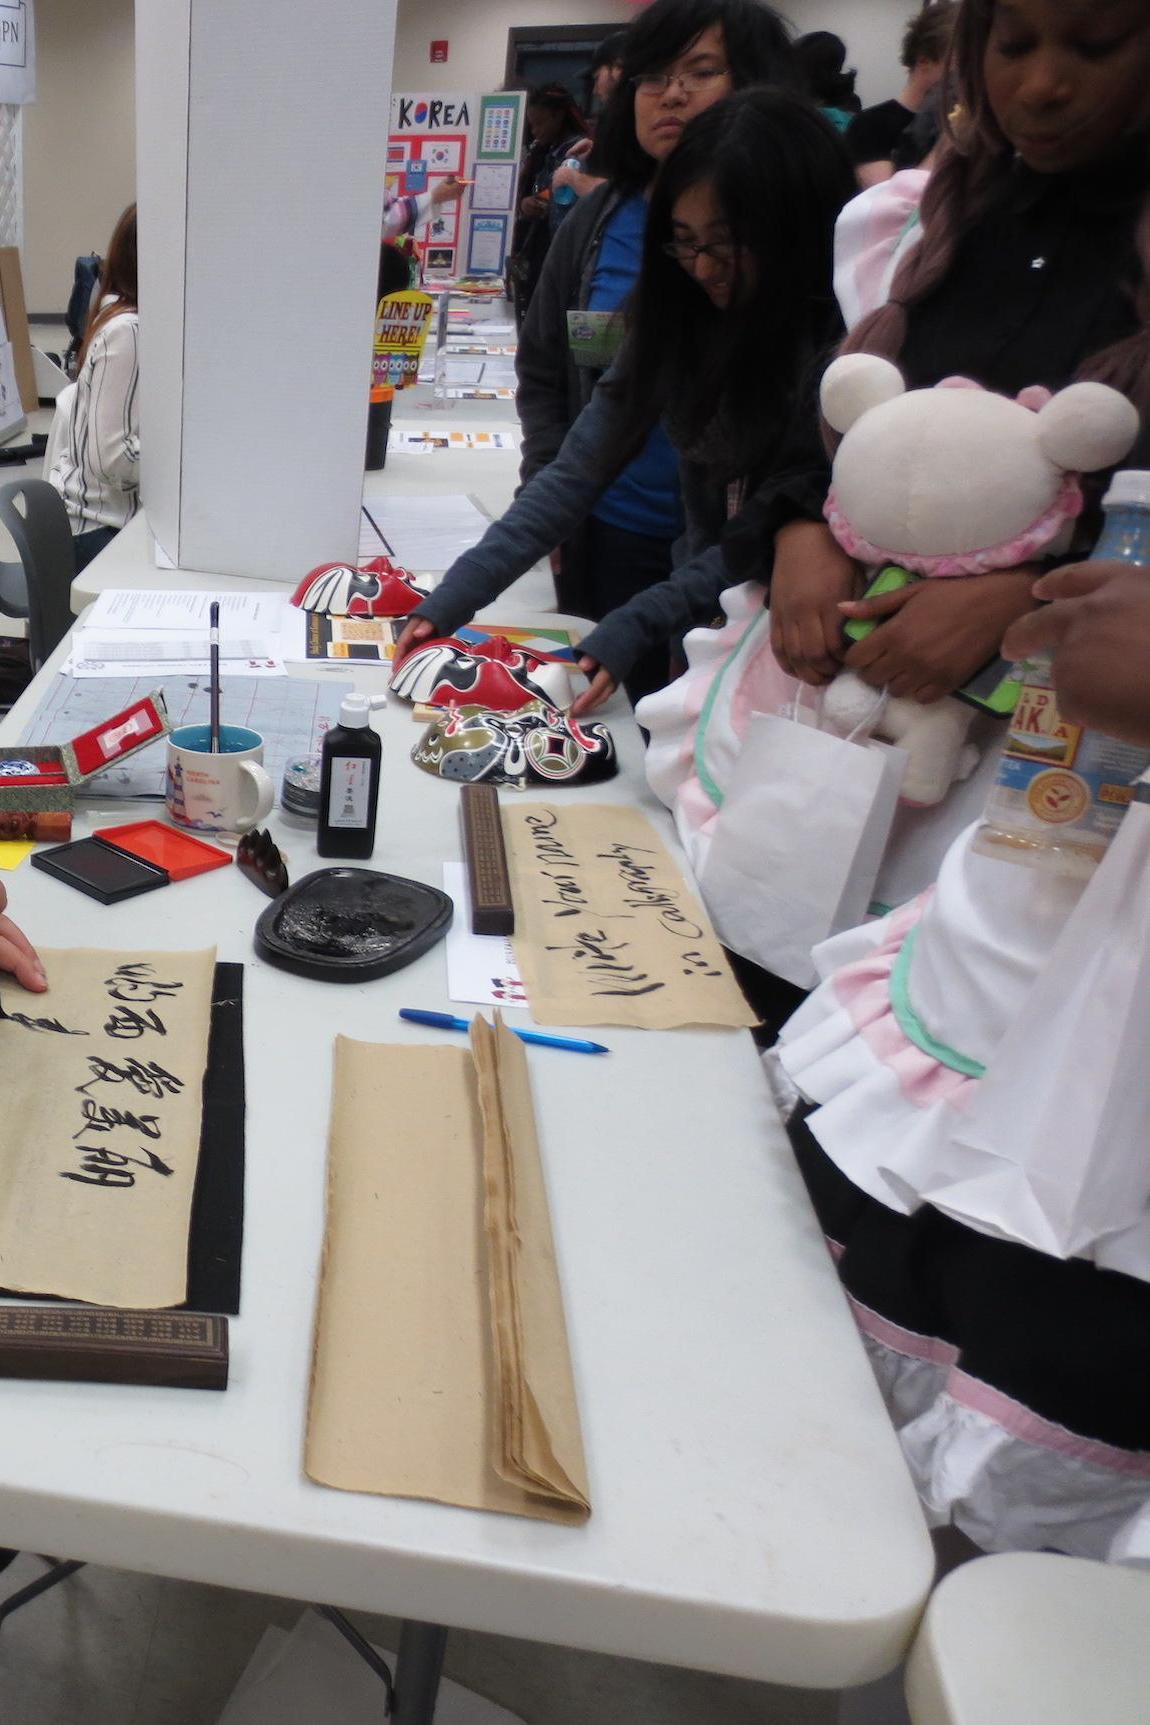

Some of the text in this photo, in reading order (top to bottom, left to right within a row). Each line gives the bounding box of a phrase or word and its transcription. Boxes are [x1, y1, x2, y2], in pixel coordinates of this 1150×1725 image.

[398, 98, 470, 129] KOREA
[378, 300, 432, 321] LINE UP
[378, 324, 421, 347] HERE!
[185, 775, 220, 785] CAROLINA
[681, 951, 723, 976] in
